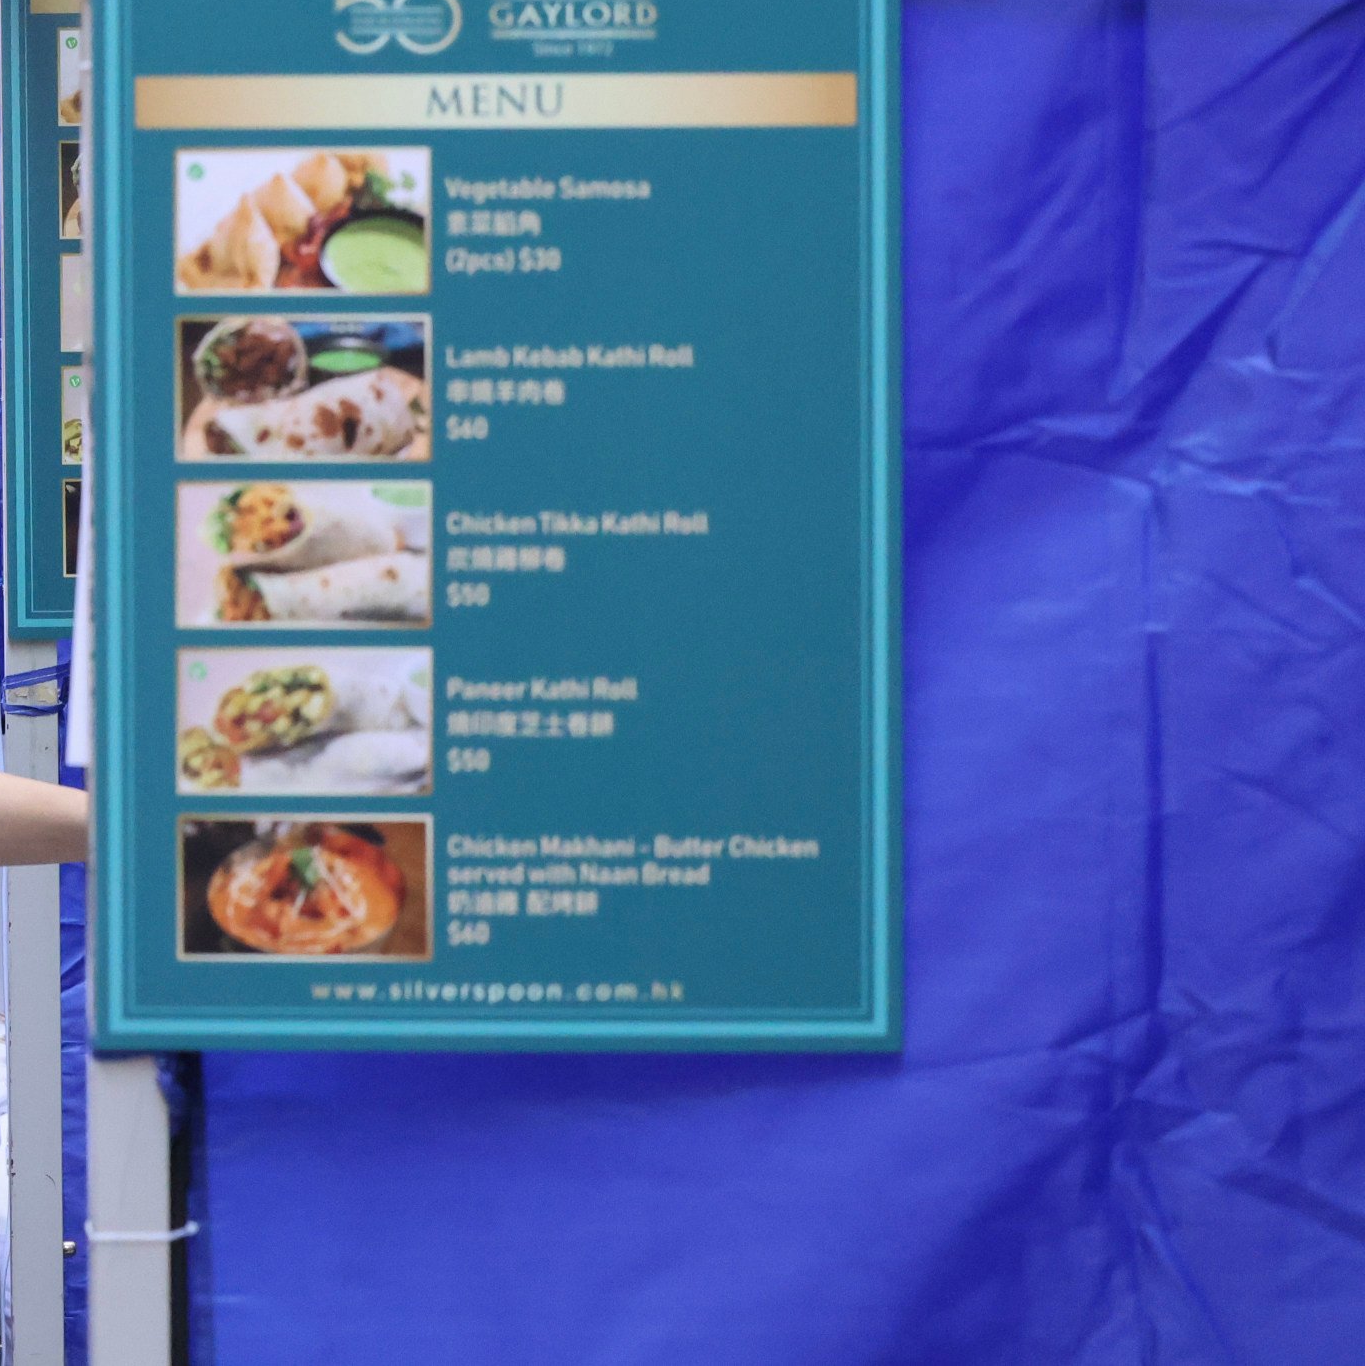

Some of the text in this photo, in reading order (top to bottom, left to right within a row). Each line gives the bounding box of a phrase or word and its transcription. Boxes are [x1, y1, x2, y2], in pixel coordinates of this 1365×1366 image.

[489, 1, 658, 28] GAYLORD
[426, 81, 565, 118] MENU
[445, 176, 651, 205] Vegetable Samosa
[445, 246, 562, 275] (2pcs) $30
[446, 343, 694, 368] Lamb Kebab Kathi Roll
[446, 510, 709, 535] Chicken Tikka Kathi Roll
[447, 676, 638, 701] Paneer Kathi Roll
[447, 835, 538, 858] Chicken
[540, 835, 635, 858] Makhani
[653, 835, 724, 858] Butter
[728, 835, 820, 858] Chicken
[447, 861, 711, 884] served with Naan Bread
[310, 979, 685, 1005] www.silverspoon.com.hk
